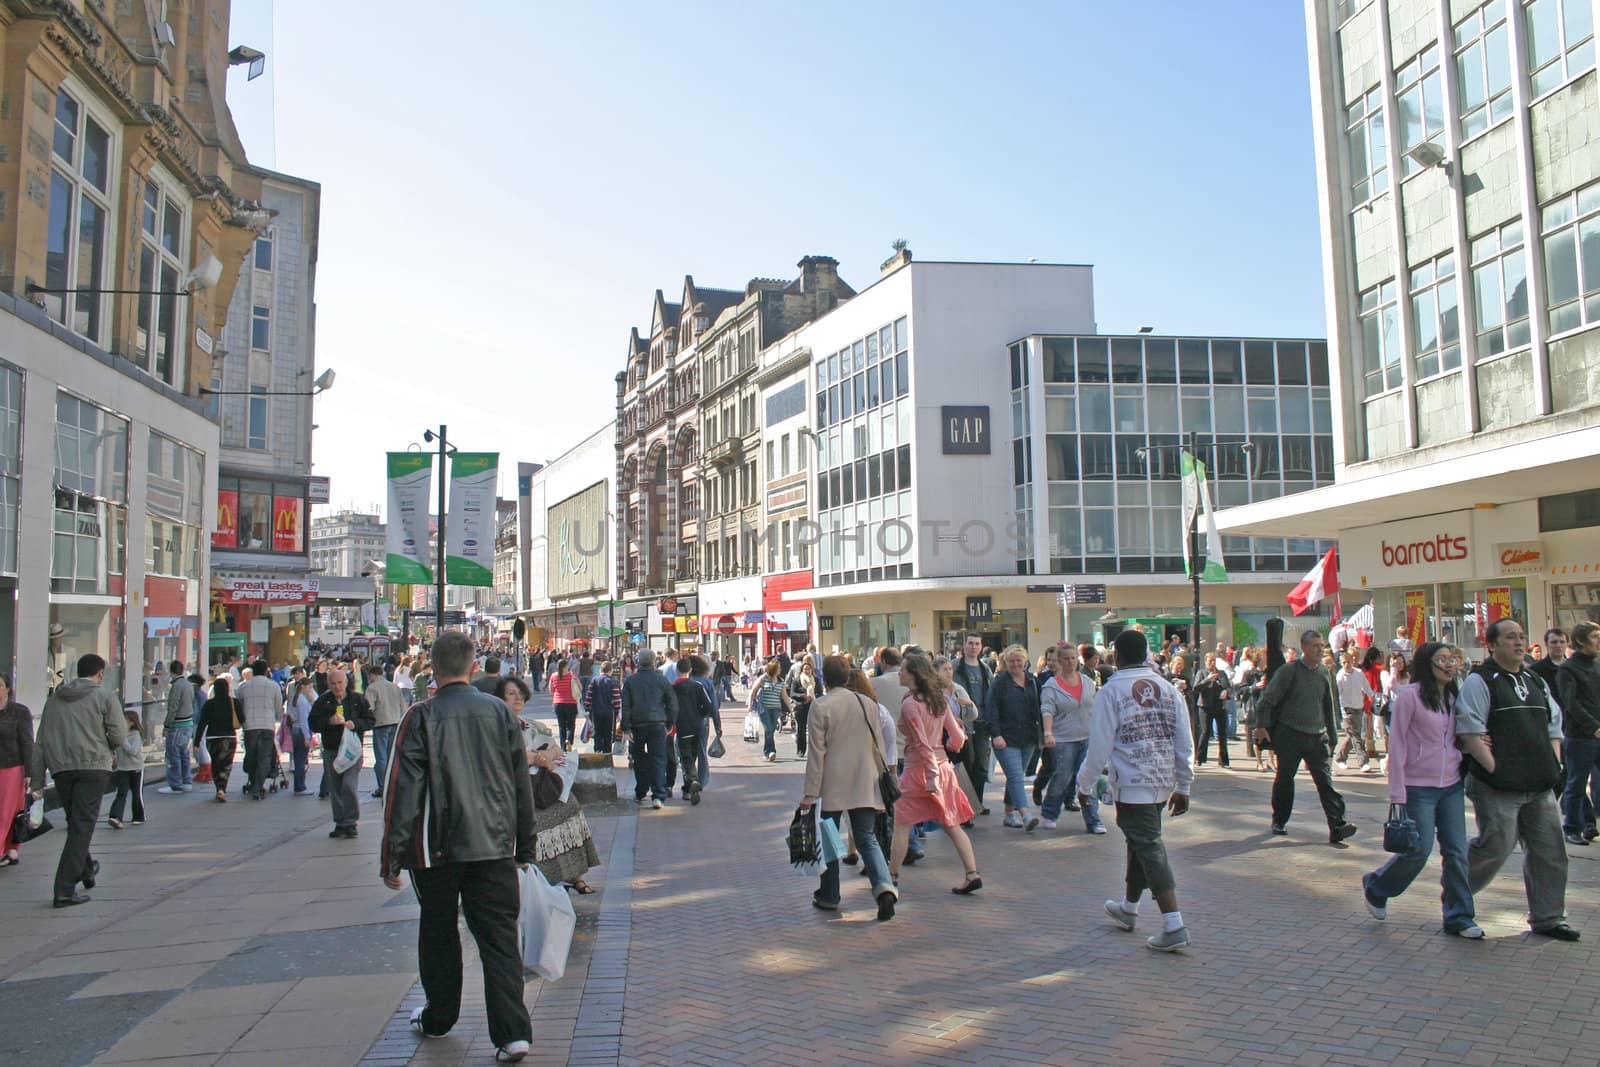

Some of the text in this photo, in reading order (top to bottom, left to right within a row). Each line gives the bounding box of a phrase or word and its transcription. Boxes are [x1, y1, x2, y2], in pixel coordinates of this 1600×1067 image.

[950, 417, 983, 443] GAP
[1381, 533, 1469, 567] barratts
[233, 581, 264, 590] great
[268, 581, 304, 591] tastes
[232, 590, 265, 600] great
[267, 590, 303, 600] prices
[969, 602, 988, 617] GAP
